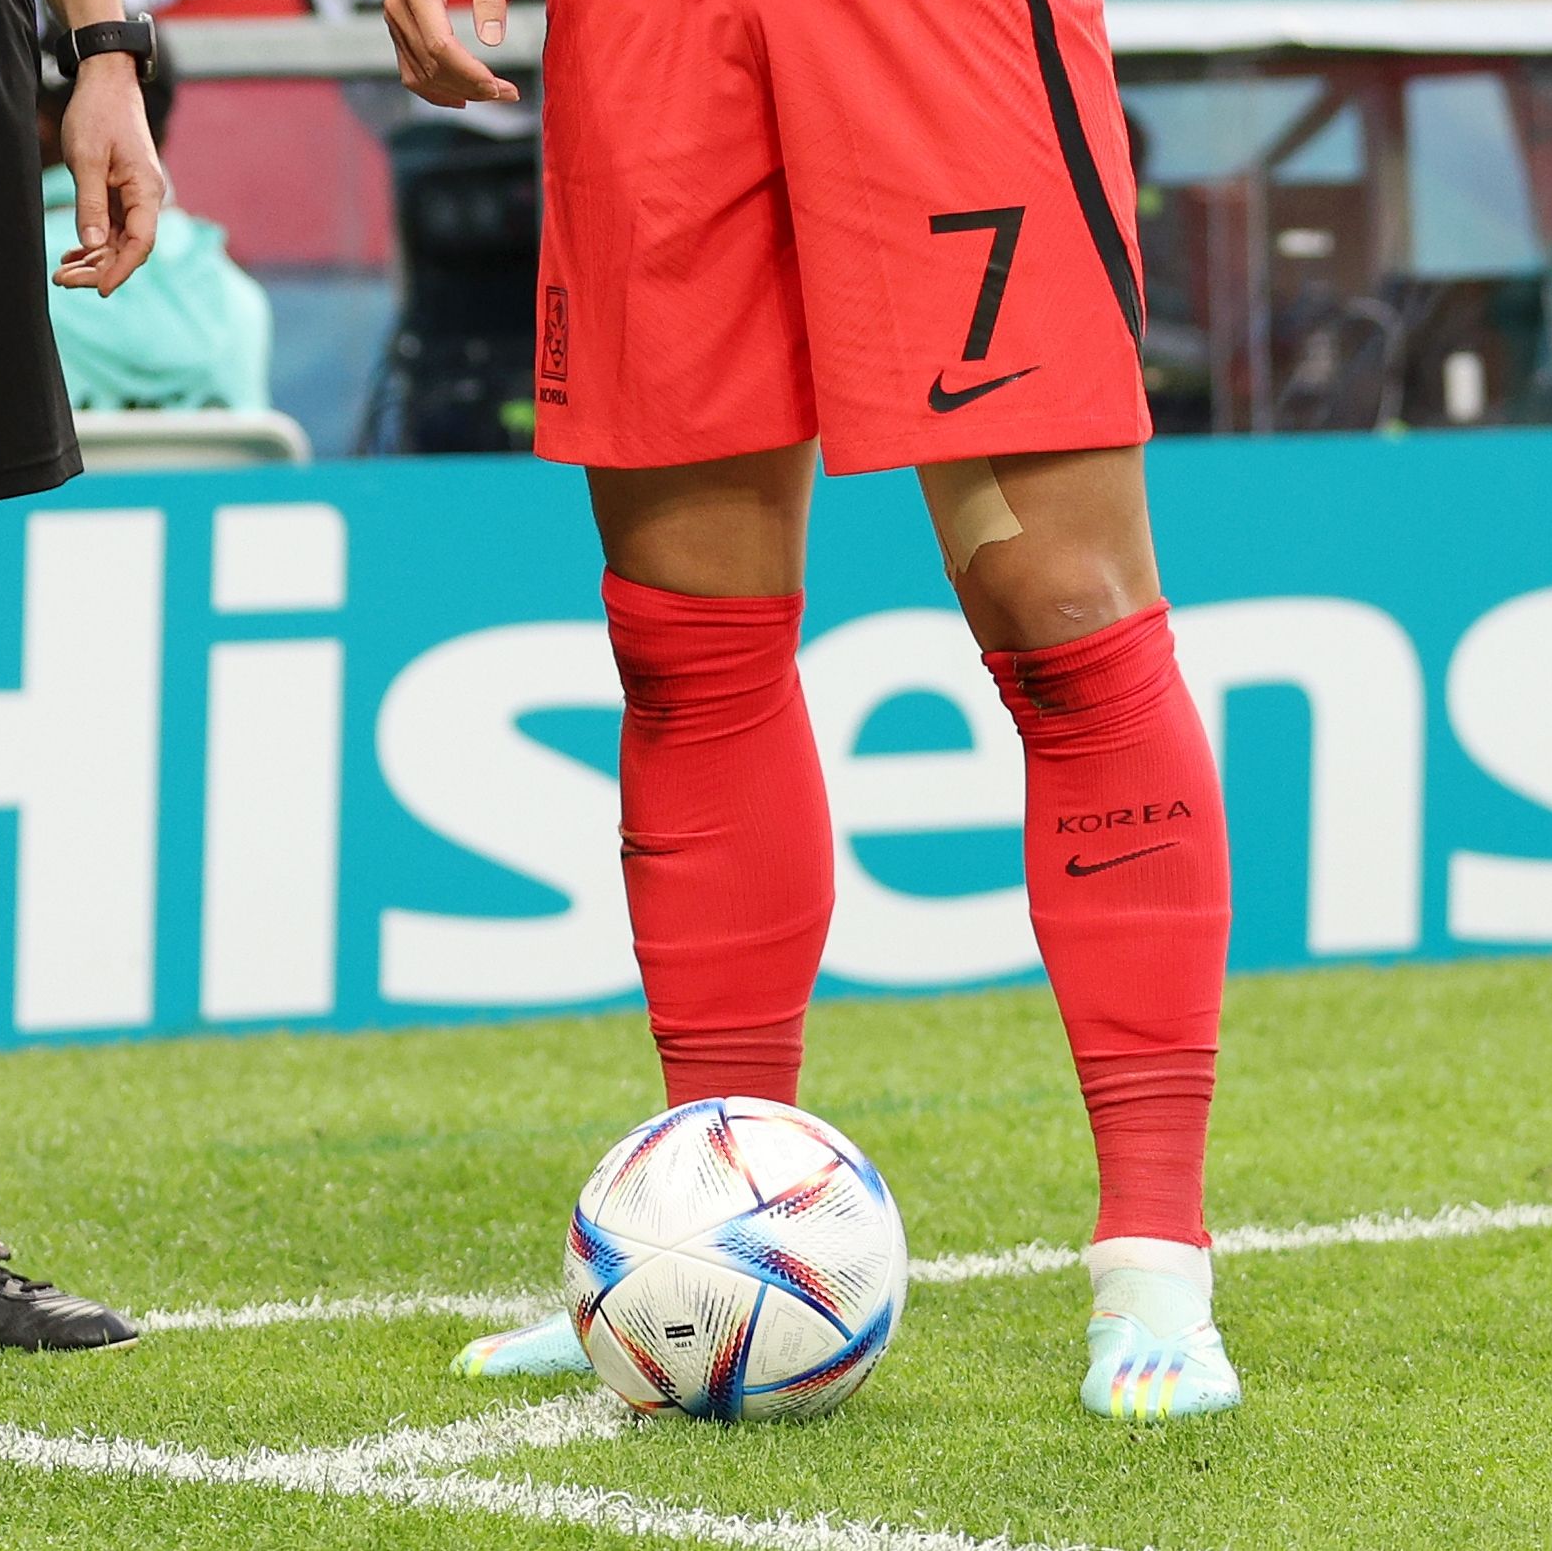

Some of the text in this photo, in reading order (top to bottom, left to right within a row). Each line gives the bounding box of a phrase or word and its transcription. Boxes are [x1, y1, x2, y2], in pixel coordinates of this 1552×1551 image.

[929, 206, 1026, 362] 7
[539, 386, 569, 408] KOREA
[1056, 800, 1192, 834] KOREA
